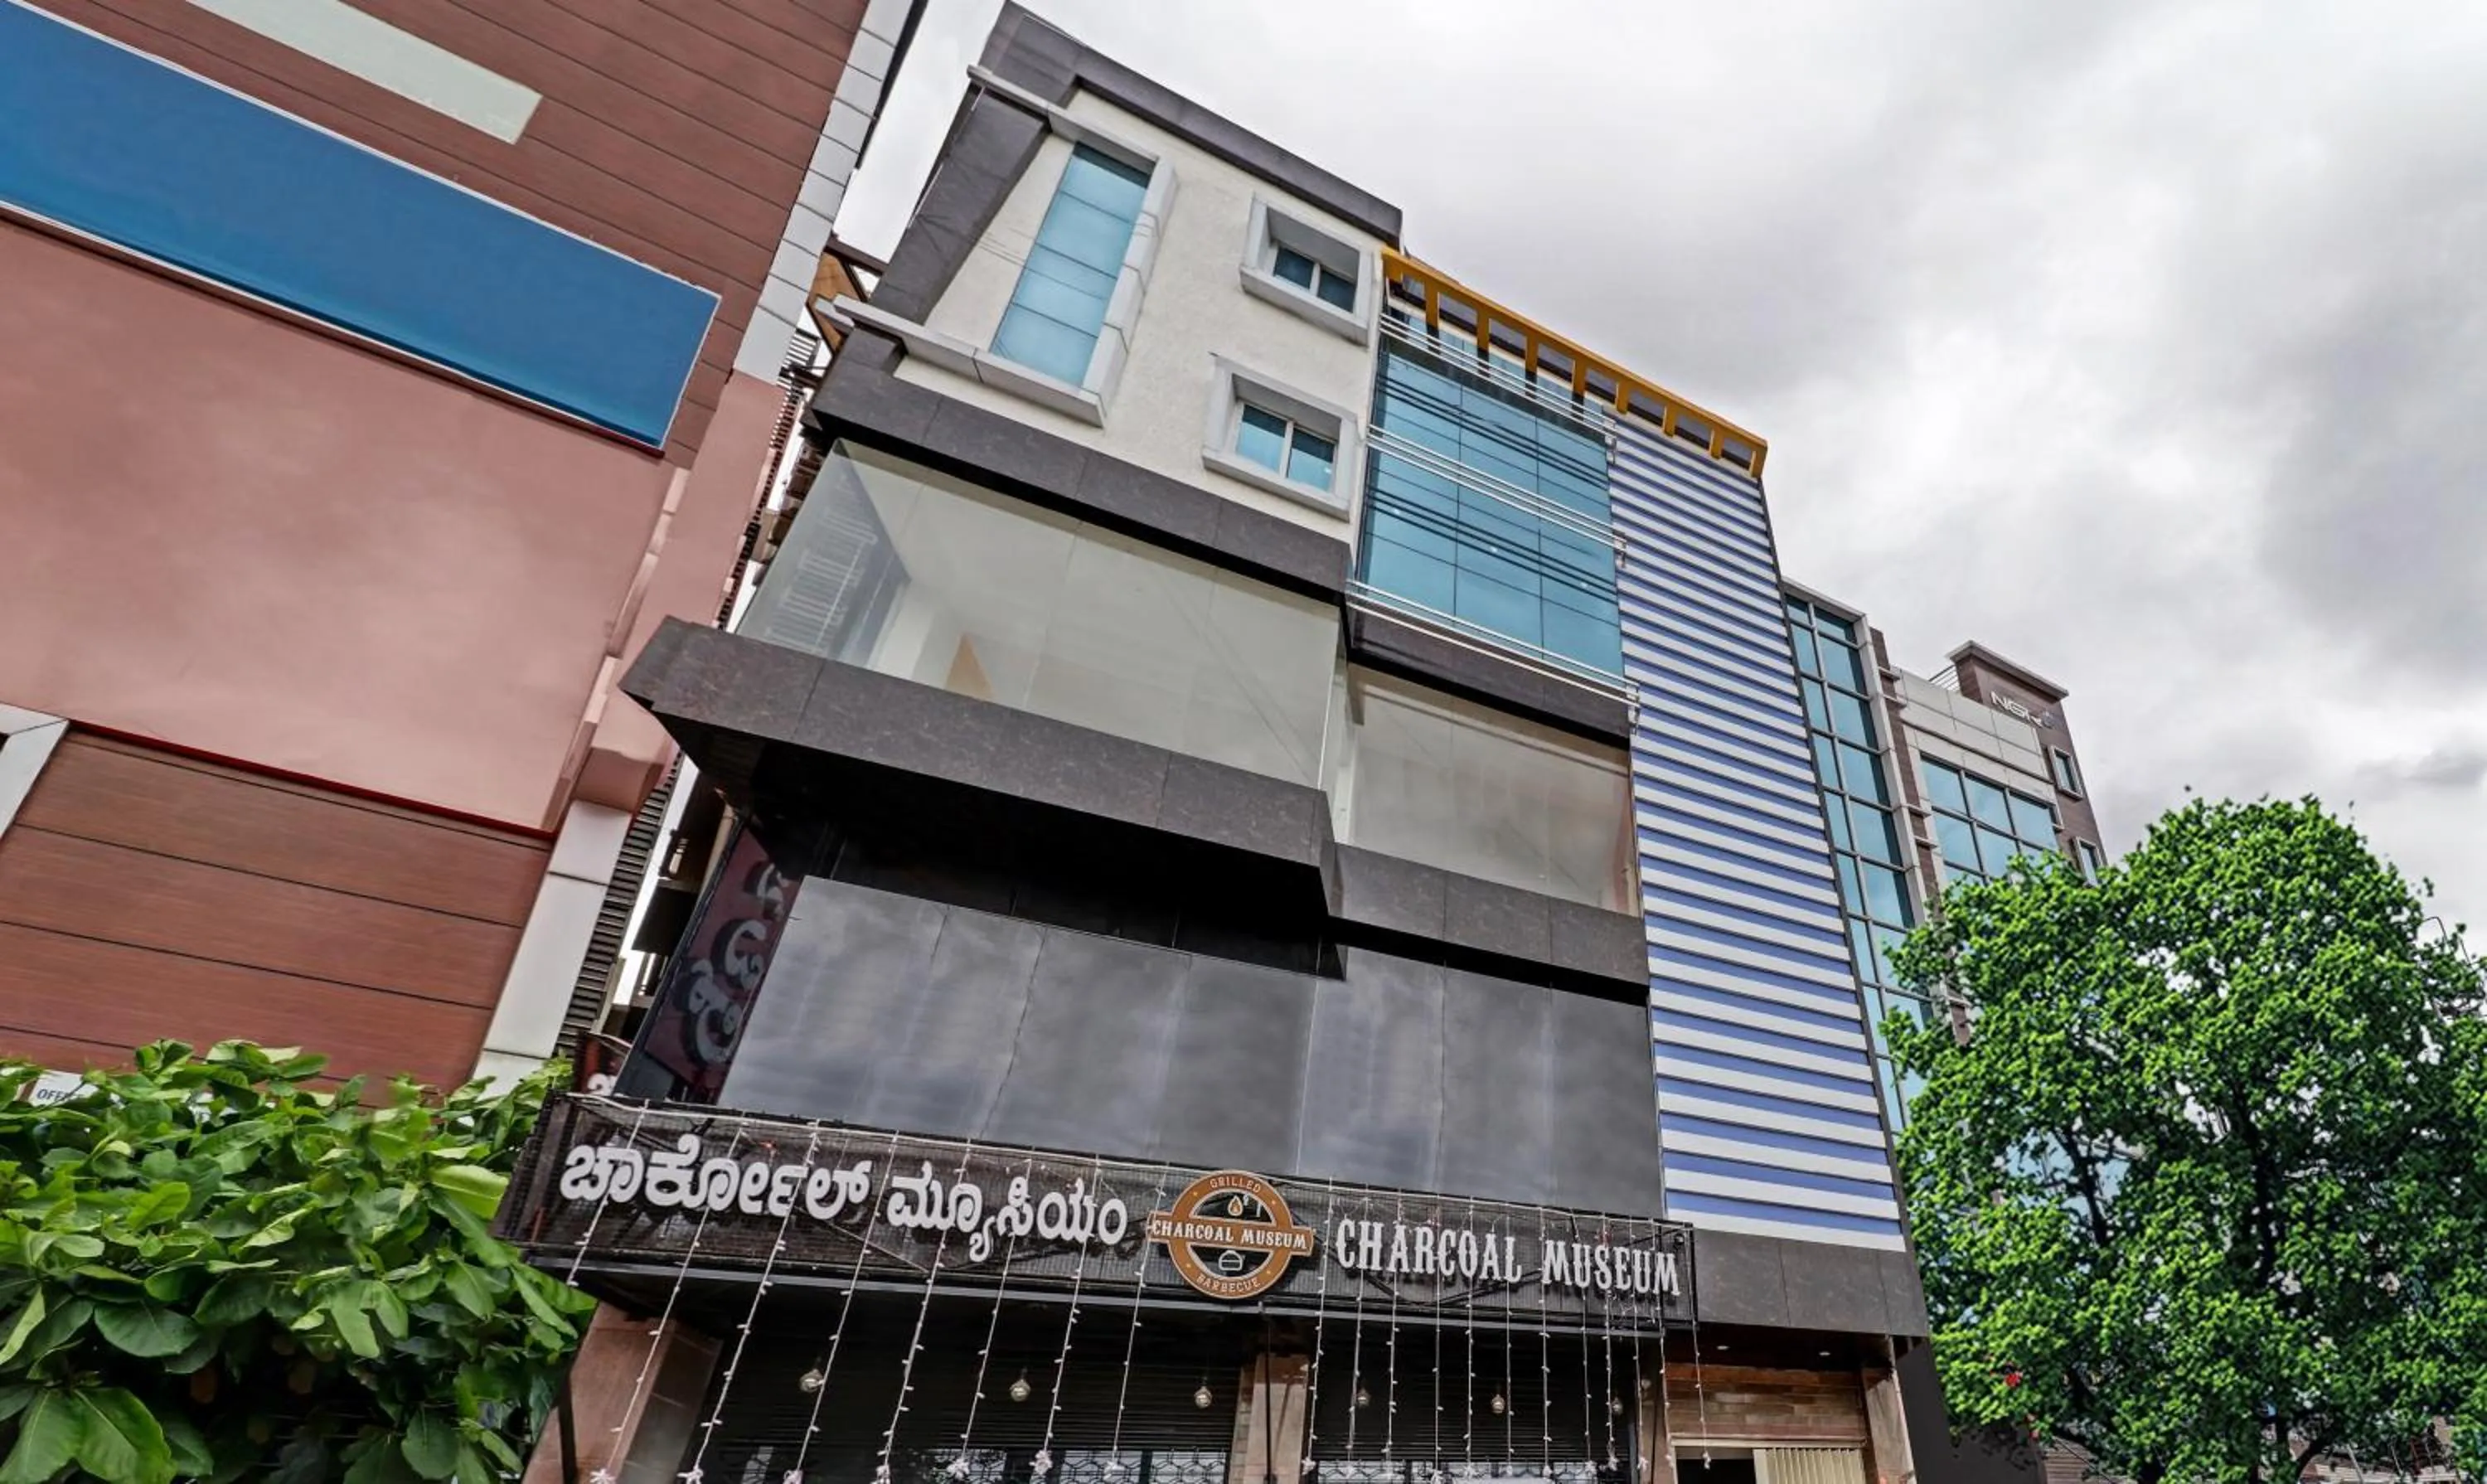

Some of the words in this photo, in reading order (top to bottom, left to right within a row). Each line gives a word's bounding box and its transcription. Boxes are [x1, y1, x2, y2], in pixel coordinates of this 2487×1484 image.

[560, 1133, 873, 1220] ಚಾರ್ಕೋಲ್
[887, 1161, 1128, 1263] ಮ್ಯೂಸಿಯಂ
[1210, 1176, 1261, 1194] GRILLED
[1151, 1220, 1234, 1242] CHARCOAL
[1241, 1227, 1307, 1249] MUSEUM
[1336, 1219, 1522, 1283] CHARCOAL
[1540, 1239, 1681, 1296] MUSEUM
[1196, 1275, 1261, 1292] BARBECUE
